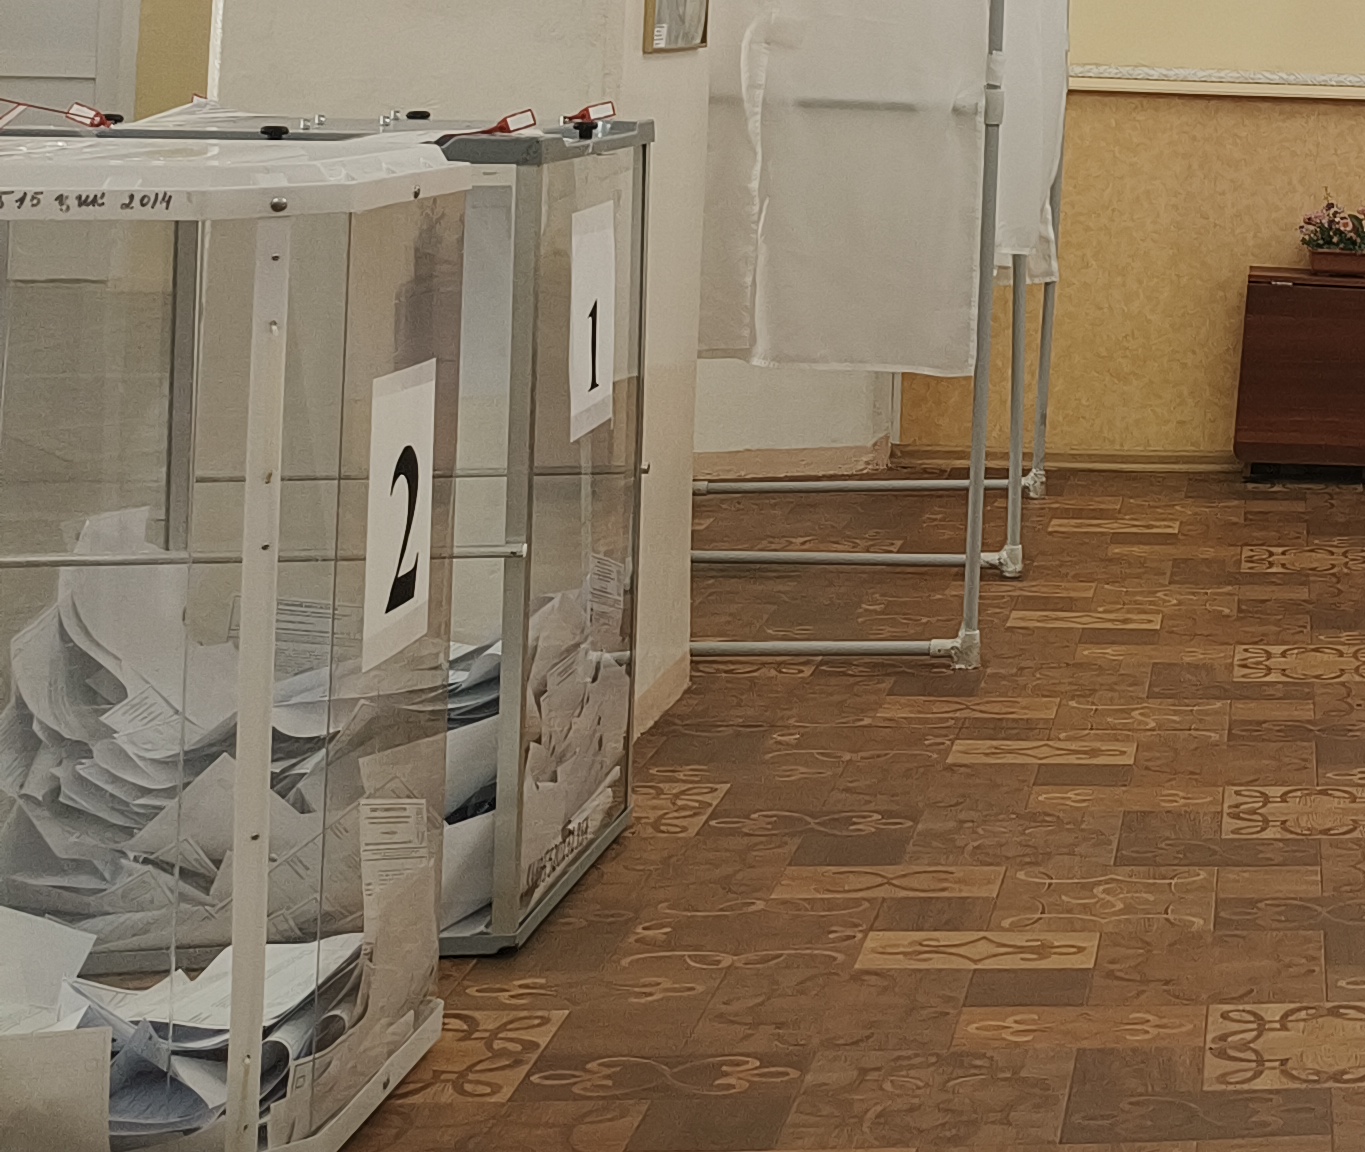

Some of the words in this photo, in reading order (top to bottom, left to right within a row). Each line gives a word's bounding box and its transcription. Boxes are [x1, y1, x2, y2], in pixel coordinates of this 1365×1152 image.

[119, 191, 173, 211] 2014
[587, 299, 600, 393] 1
[384, 445, 419, 614] 2
